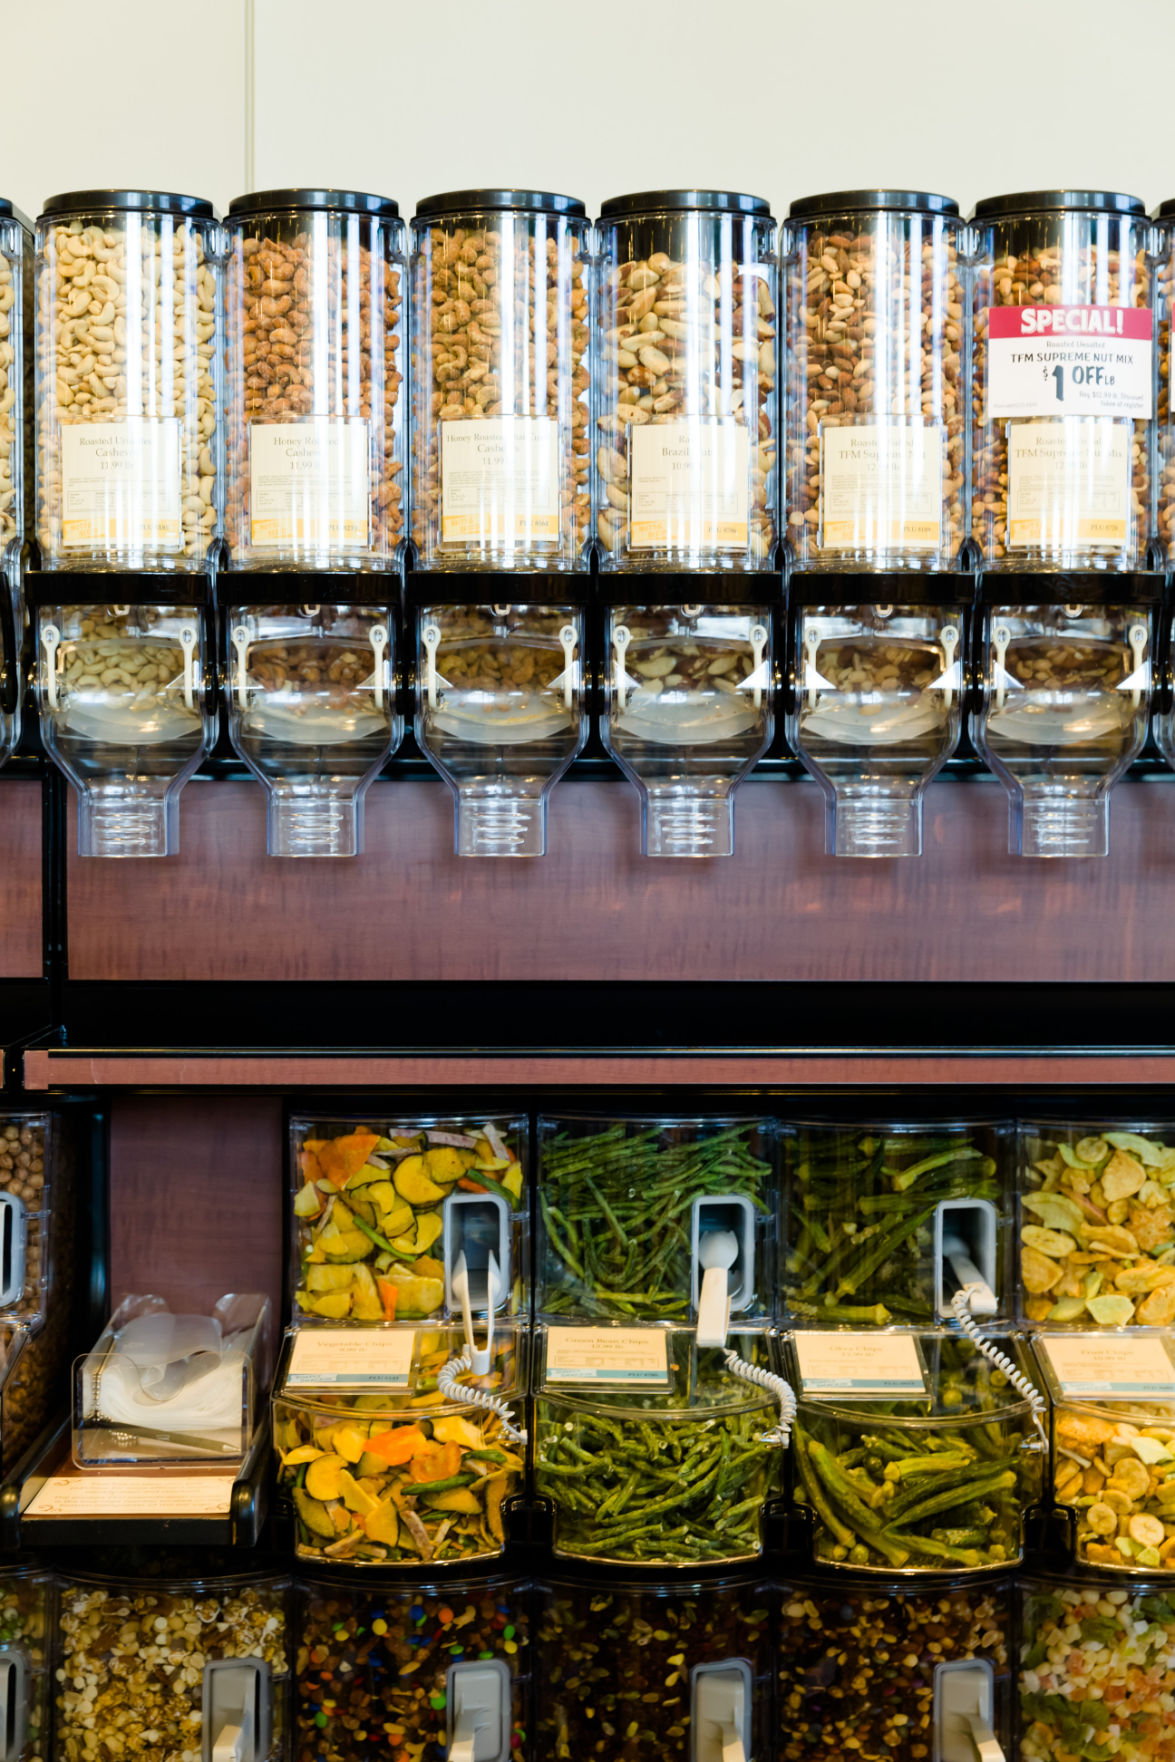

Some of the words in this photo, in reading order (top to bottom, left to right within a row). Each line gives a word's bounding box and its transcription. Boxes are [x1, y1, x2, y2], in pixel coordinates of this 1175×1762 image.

[1020, 308, 1124, 335] SPECIAL!
[1010, 353, 1034, 363] TFM
[1036, 351, 1090, 362] SUPREME
[1093, 352, 1113, 362] NUT
[1116, 353, 1134, 365] MIX
[1072, 365, 1104, 385] OFF
[80, 437, 112, 446] Roasted
[272, 437, 302, 447] Honey
